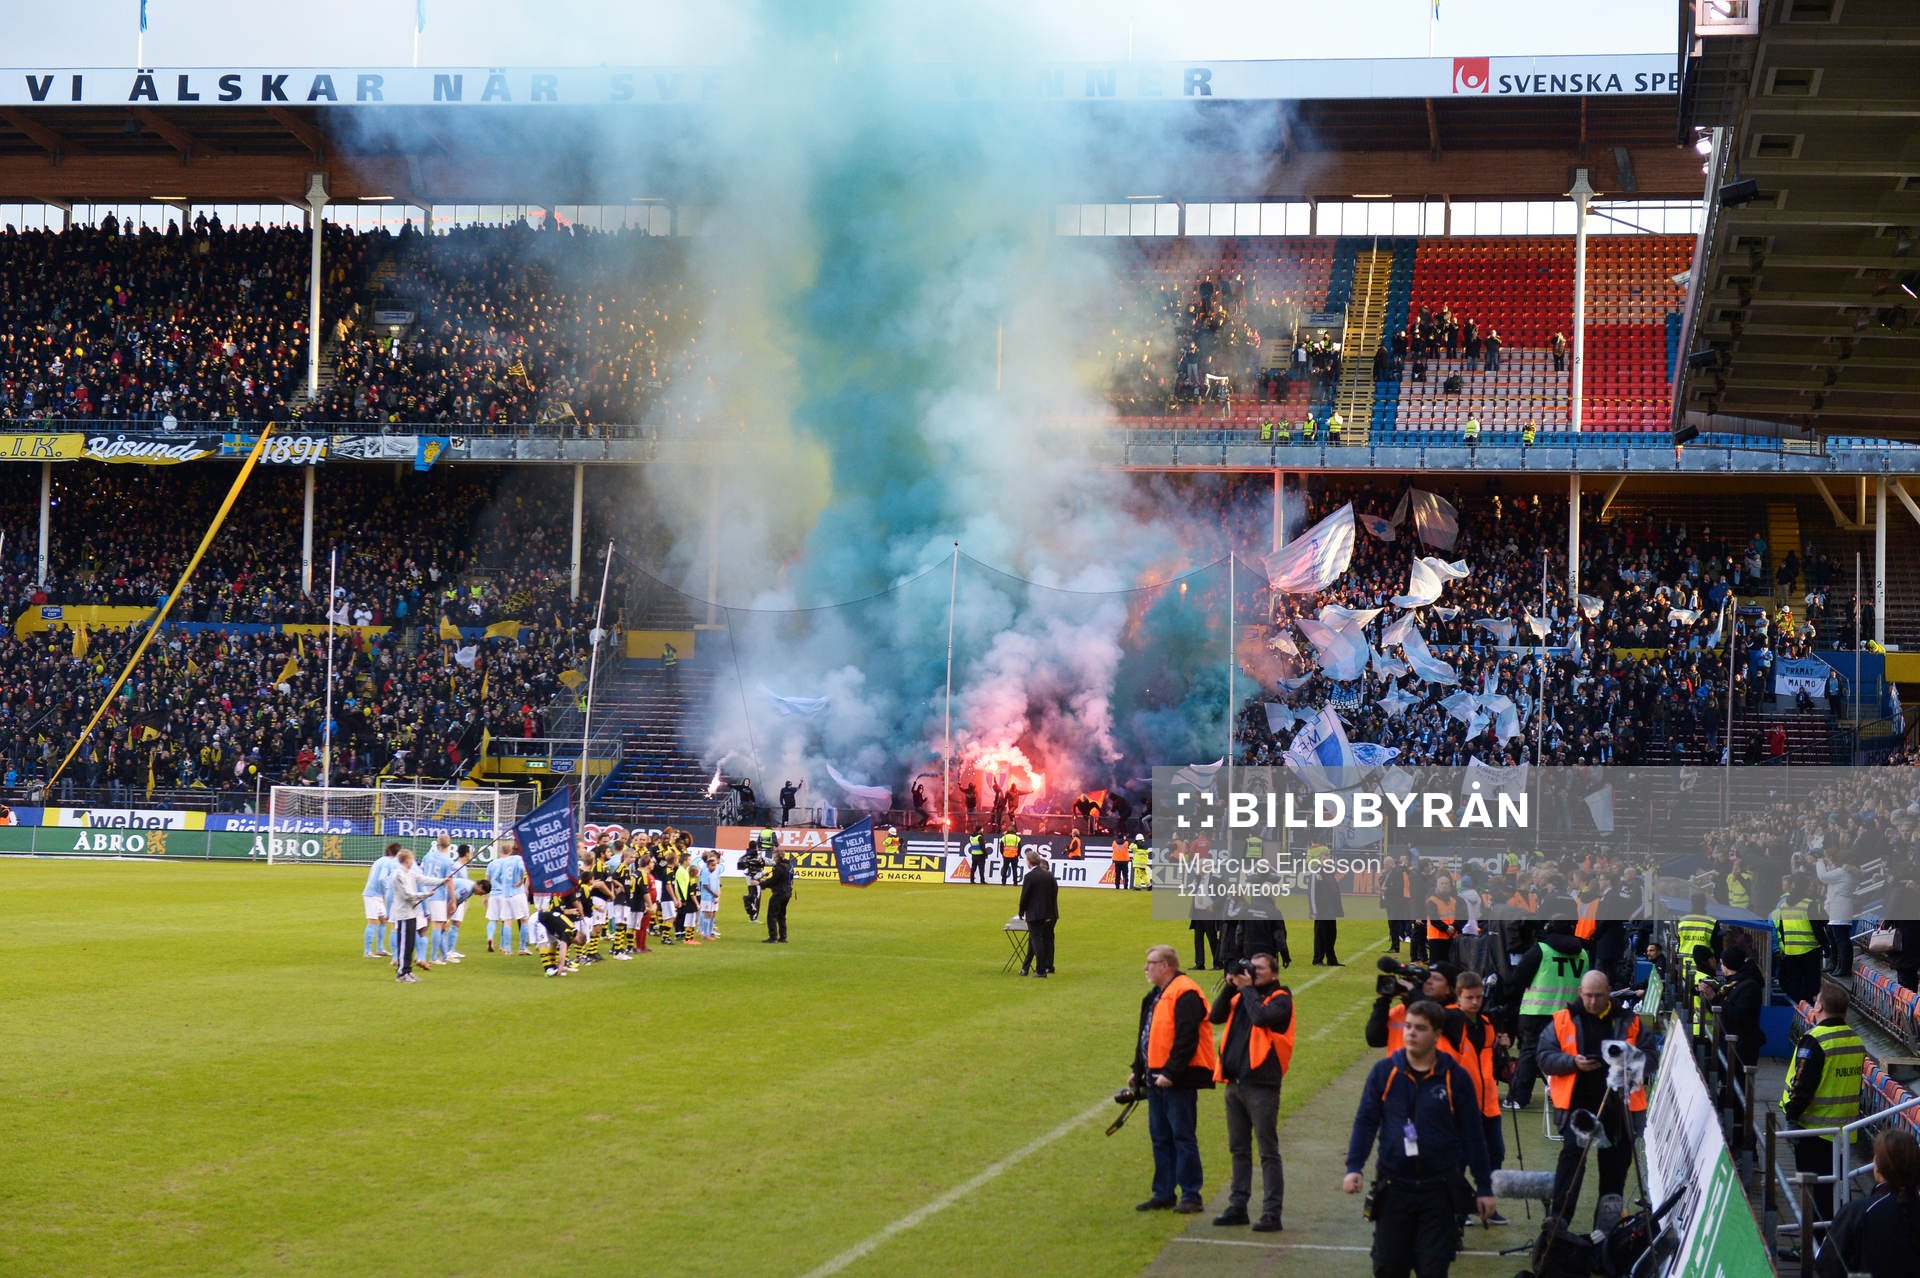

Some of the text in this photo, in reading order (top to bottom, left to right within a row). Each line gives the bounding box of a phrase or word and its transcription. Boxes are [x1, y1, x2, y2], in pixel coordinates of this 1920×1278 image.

[25, 75, 83, 101] VI
[128, 69, 386, 102] ÄLSKAR
[433, 69, 560, 102] NÄR
[1498, 73, 1623, 95] SVENSKA
[85, 434, 206, 462] Råsunda
[260, 435, 328, 465] 1891
[90, 811, 174, 830] weber
[534, 820, 562, 837] HELA
[73, 831, 145, 852] ÅBRO
[248, 835, 320, 857] ÅBRO
[845, 837, 865, 848] HELA
[887, 873, 922, 881] NACKA
[1052, 863, 1087, 881] Lim
[1551, 956, 1585, 979] TV
